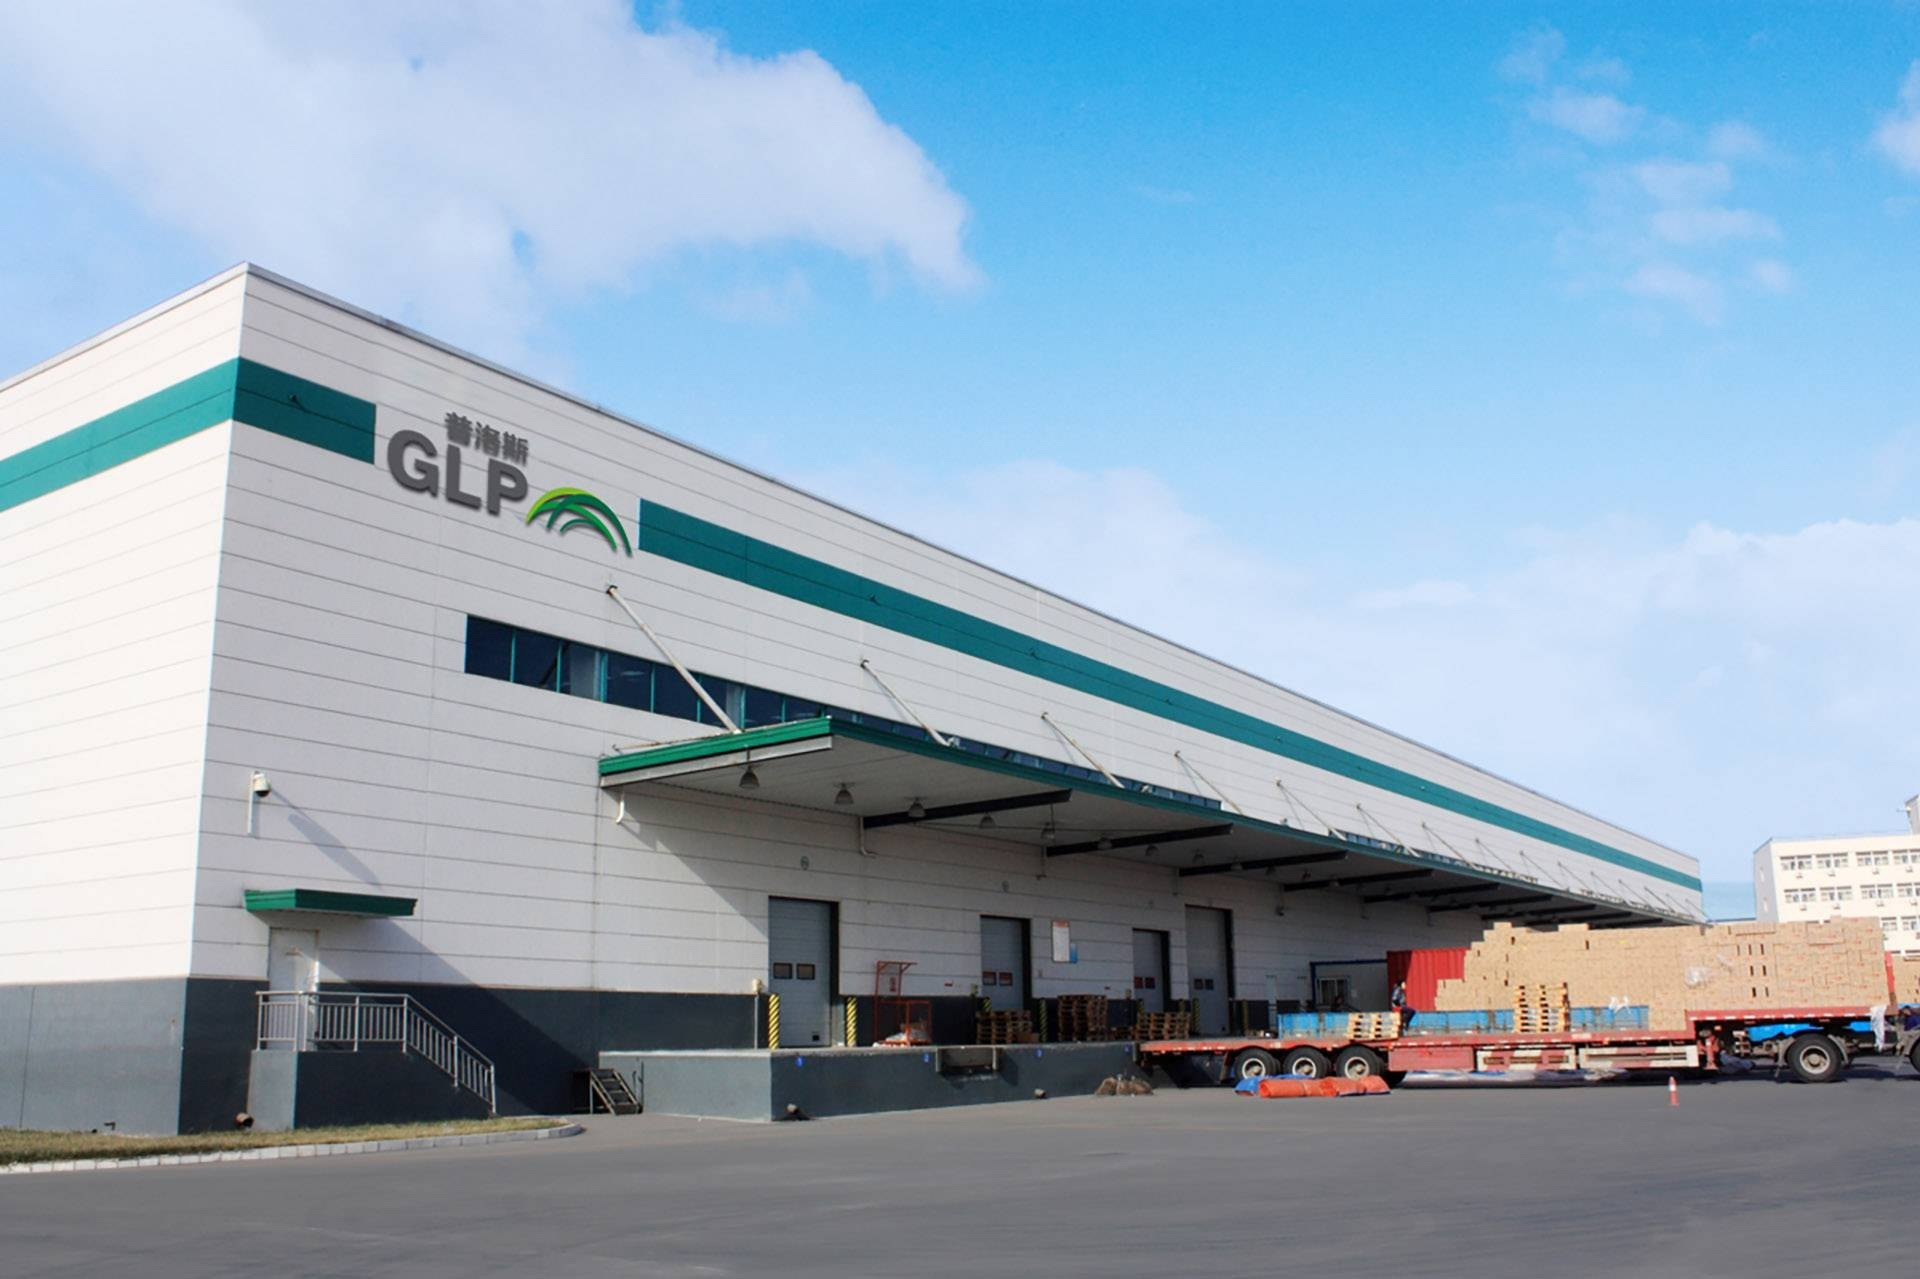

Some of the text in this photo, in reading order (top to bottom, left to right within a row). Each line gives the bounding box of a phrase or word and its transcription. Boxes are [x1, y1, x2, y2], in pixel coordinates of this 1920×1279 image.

[387, 429, 528, 516] GLP
[445, 412, 528, 466] 普洛斯
